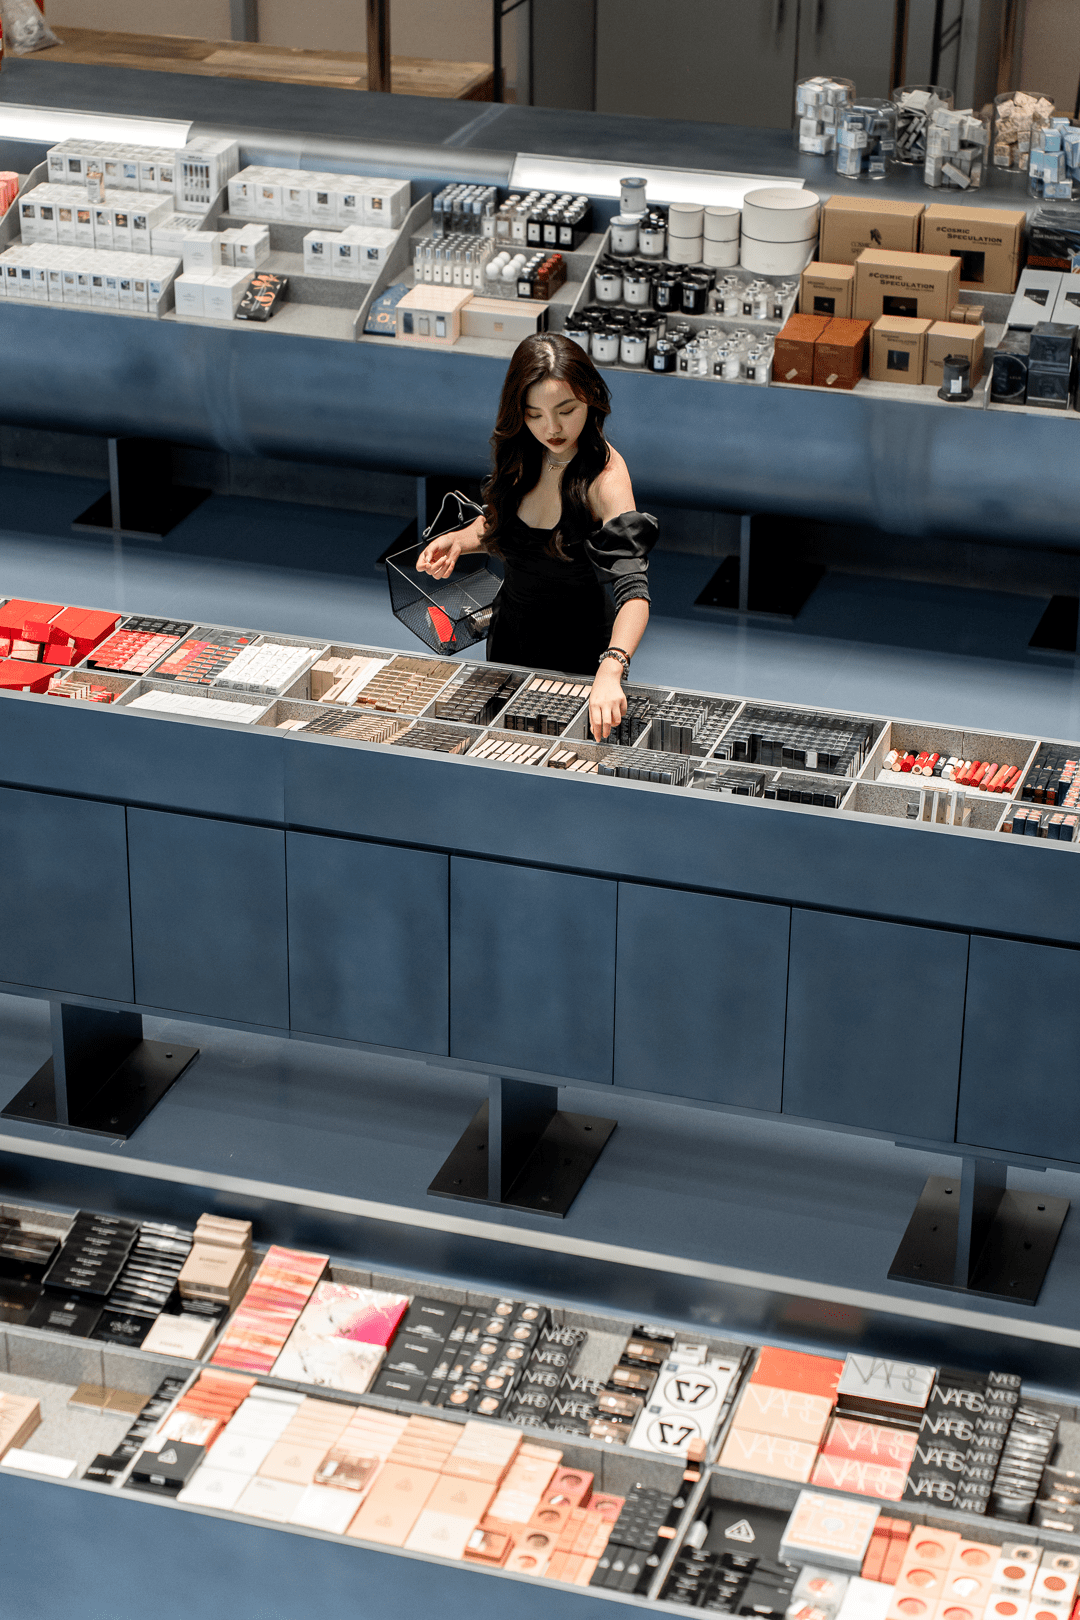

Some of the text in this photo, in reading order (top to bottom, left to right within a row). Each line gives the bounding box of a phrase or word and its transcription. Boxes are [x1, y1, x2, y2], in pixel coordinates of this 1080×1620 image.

[947, 233, 1002, 243] SPECULATION
[880, 279, 934, 289] SPECULATION
[931, 1385, 984, 1412] NARS
[919, 1414, 975, 1441] NARS
[911, 1444, 966, 1472] NARS
[903, 1475, 957, 1502] NARS
